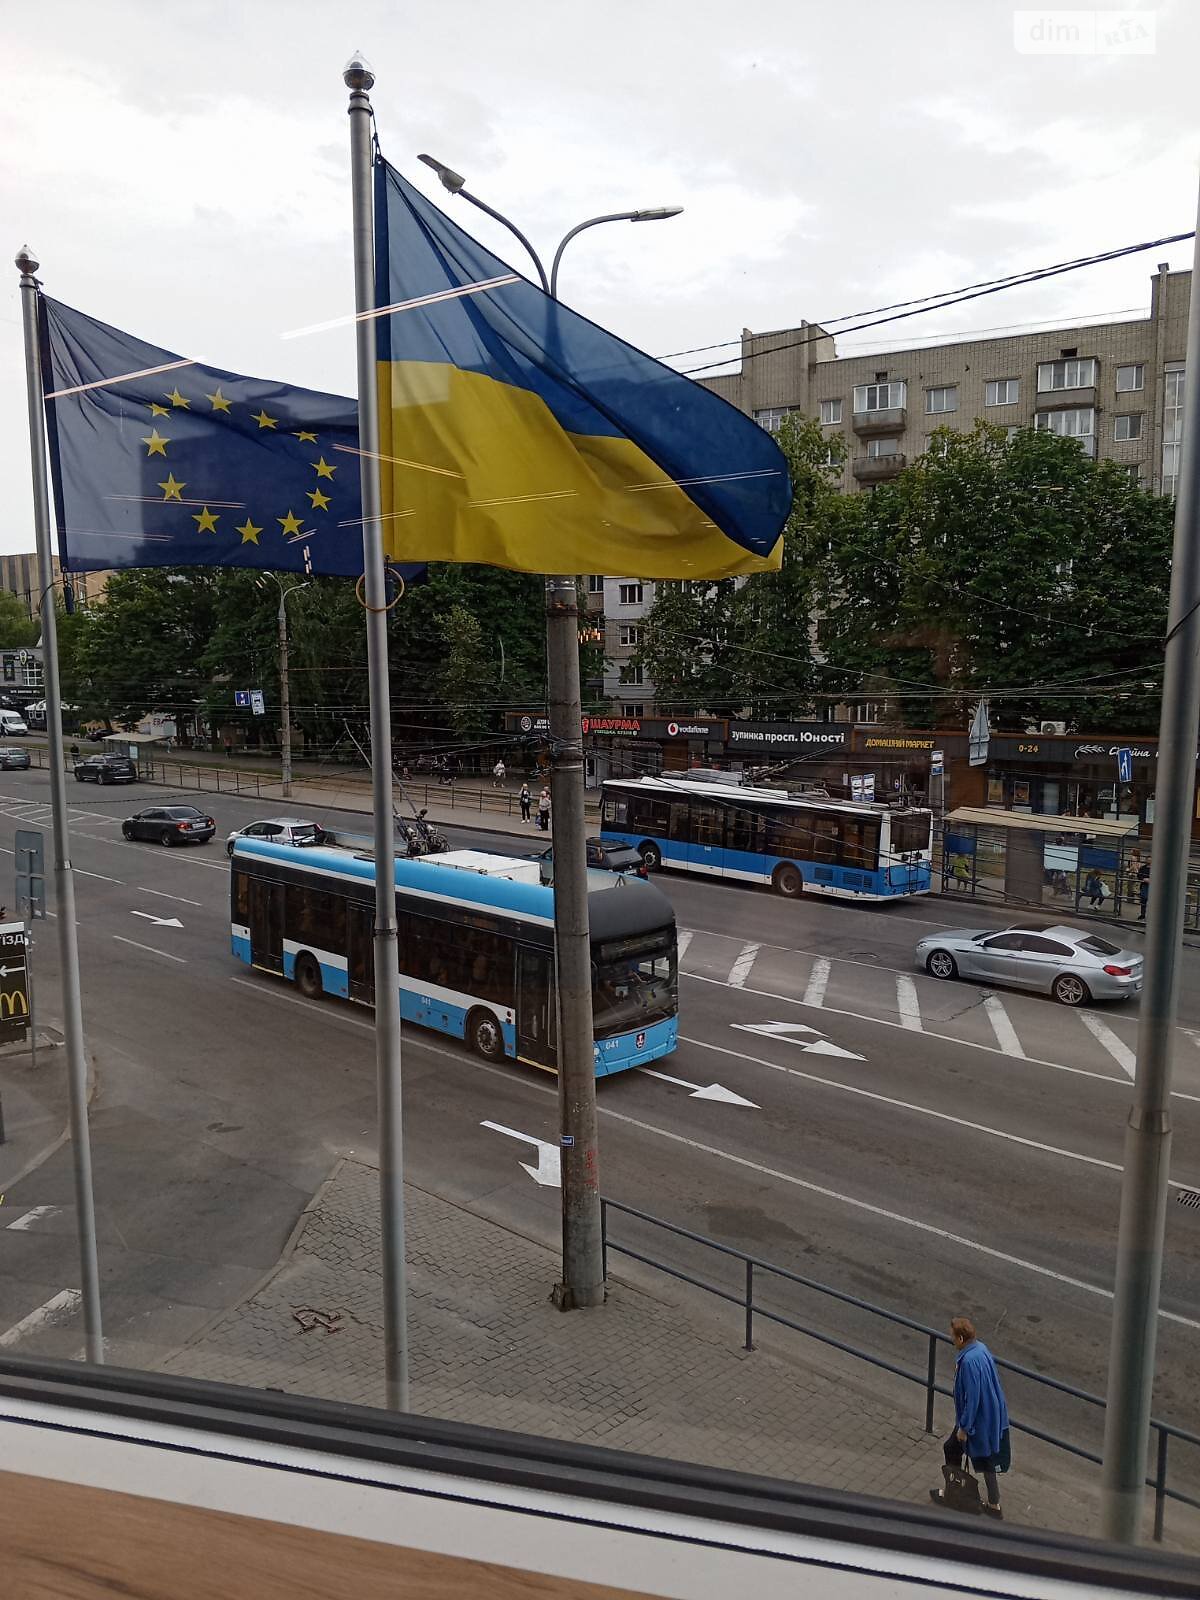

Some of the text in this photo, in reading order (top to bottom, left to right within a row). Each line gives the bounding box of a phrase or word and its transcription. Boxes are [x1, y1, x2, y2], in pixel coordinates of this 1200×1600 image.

[590, 718, 641, 731] ШАУРМА
[678, 725, 709, 734] vodafone
[731, 730, 845, 744] зупинка просп. Юності
[905, 740, 935, 749] МАРКЕТ
